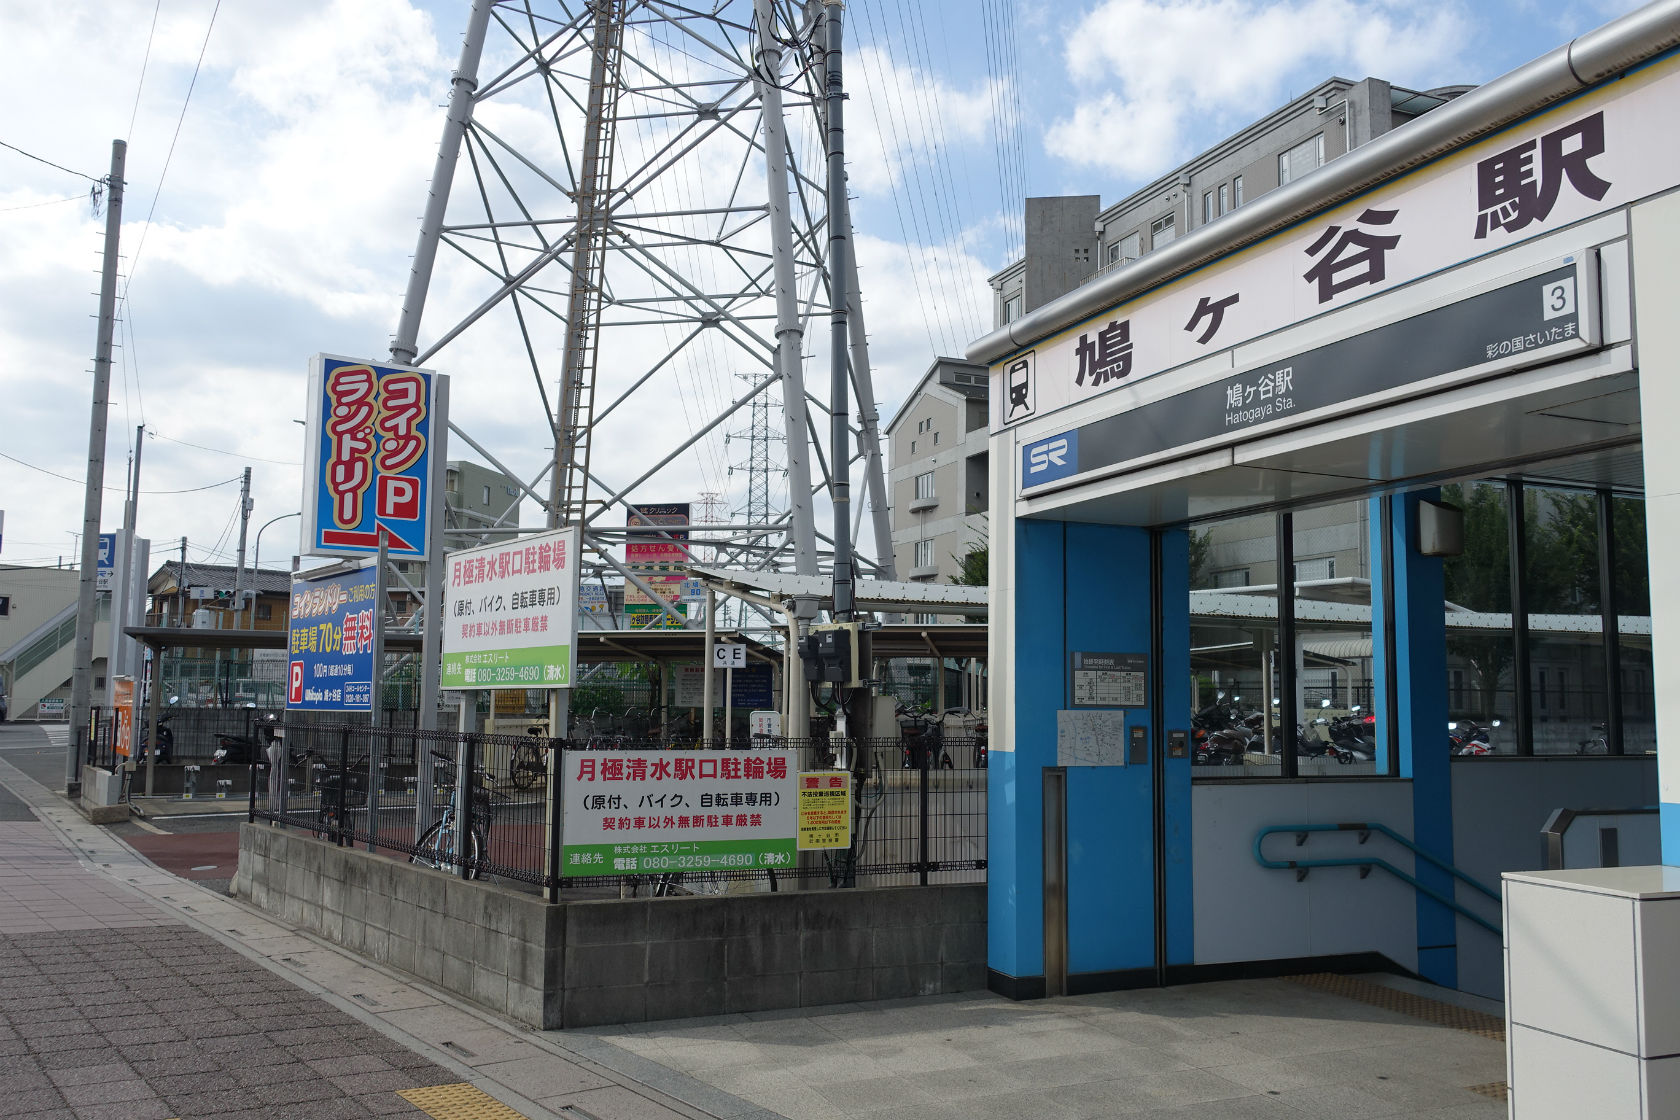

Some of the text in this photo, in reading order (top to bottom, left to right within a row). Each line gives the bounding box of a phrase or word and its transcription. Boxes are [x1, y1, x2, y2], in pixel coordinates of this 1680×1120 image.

[1551, 285, 1566, 311] 3
[1486, 322, 1576, 358] 彩の国さいたま
[380, 376, 422, 472] コイン
[1225, 397, 1296, 426] Hatogaya Sta.
[333, 371, 375, 523] ランドリー
[1030, 438, 1068, 474] SR
[386, 479, 413, 515] P
[452, 540, 566, 587] 月極清水駅口駐輪場
[292, 582, 376, 619] コインランドリー ご利用の方
[342, 608, 373, 655] 無料
[462, 614, 548, 639] 契約車以外無断駐車厳禁
[483, 652, 510, 664] エスリート
[291, 666, 302, 700] P
[478, 666, 540, 682] 080-3259-4690
[576, 757, 788, 782] 月極清水駅口駐輪場
[806, 777, 842, 788] 警告
[602, 813, 762, 831] 契約車以外無断駐車厳禁
[569, 852, 604, 865] 連絡先
[613, 857, 638, 871] 電話
[643, 853, 753, 869] 080-3259-4690
[614, 843, 700, 854] 株式会社 エスリート
